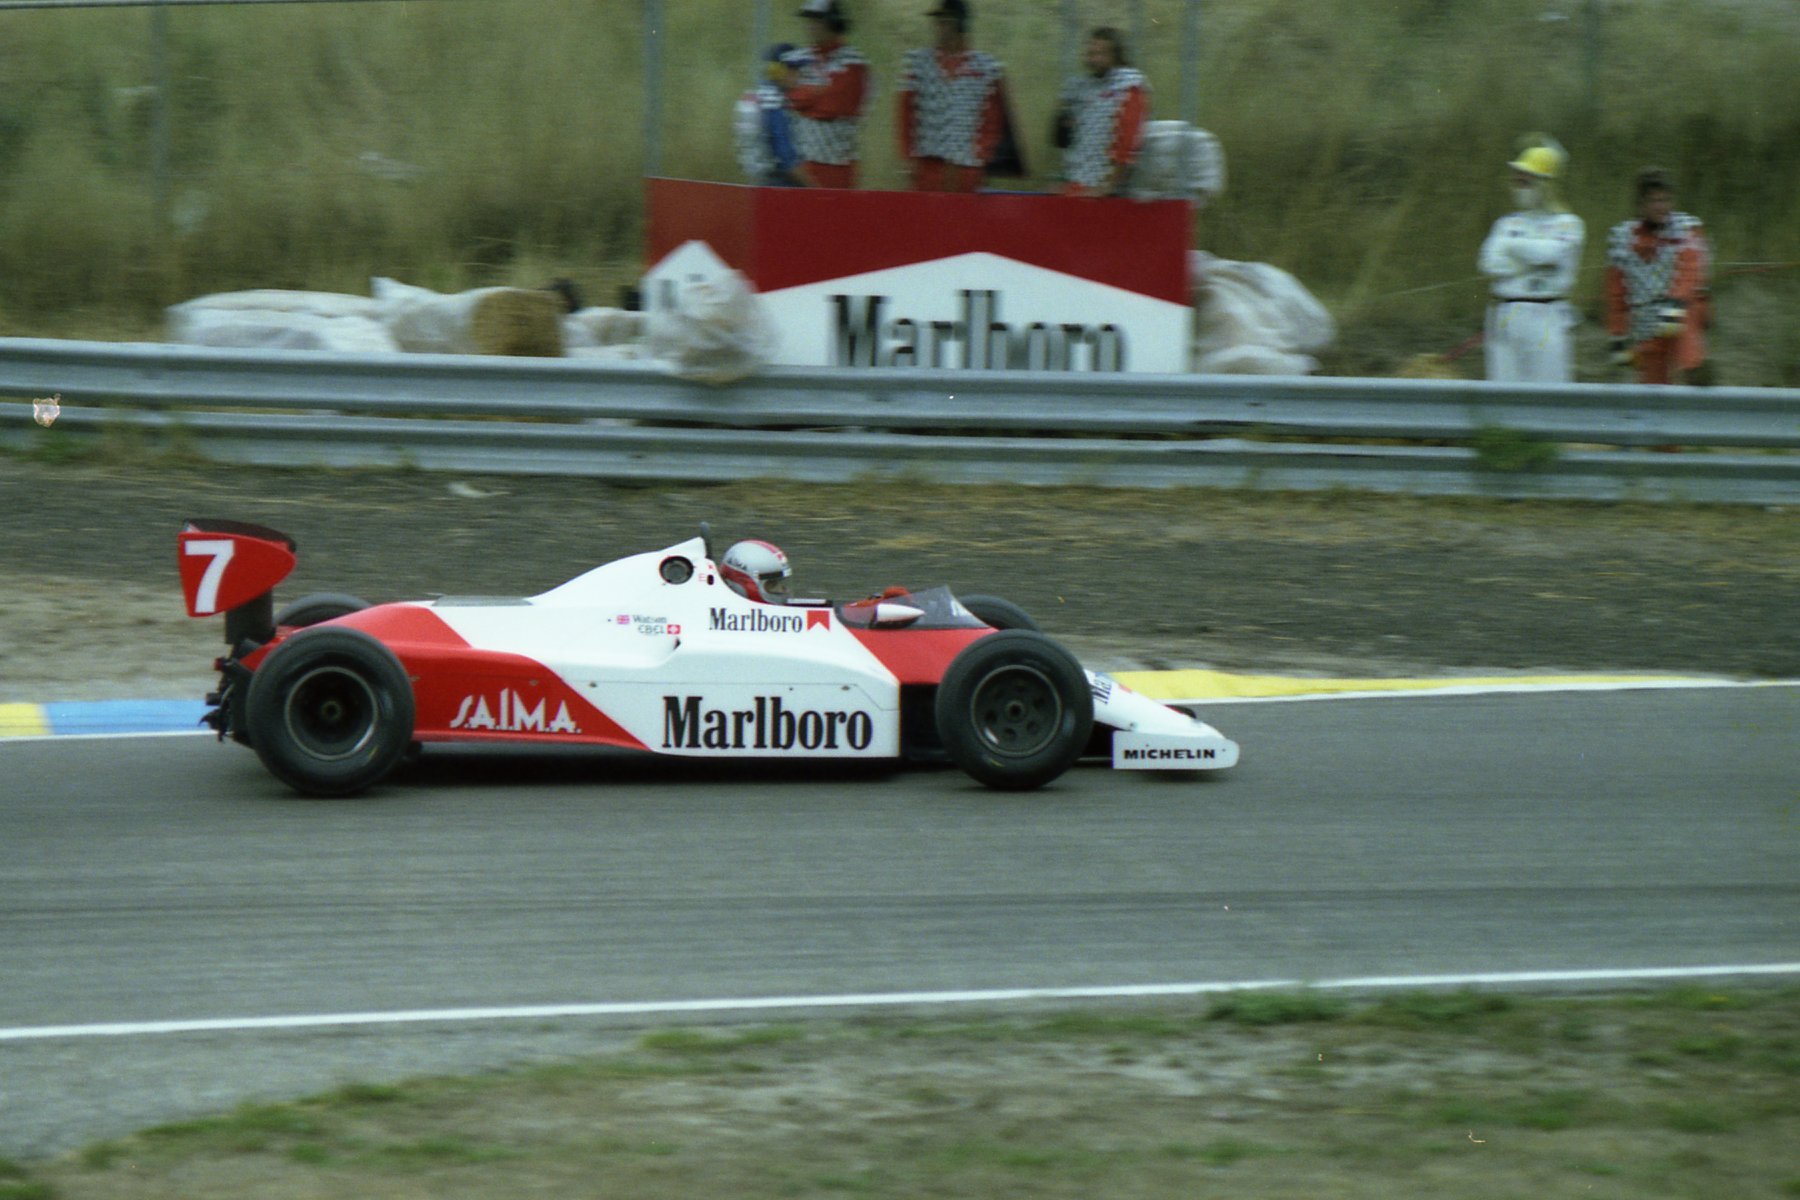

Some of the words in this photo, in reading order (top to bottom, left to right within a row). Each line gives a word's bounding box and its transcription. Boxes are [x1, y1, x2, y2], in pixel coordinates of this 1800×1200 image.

[184, 539, 235, 614] 7
[709, 607, 803, 633] Marlboro
[662, 696, 873, 750] Marlboro
[1123, 748, 1216, 760] MICHELIN
